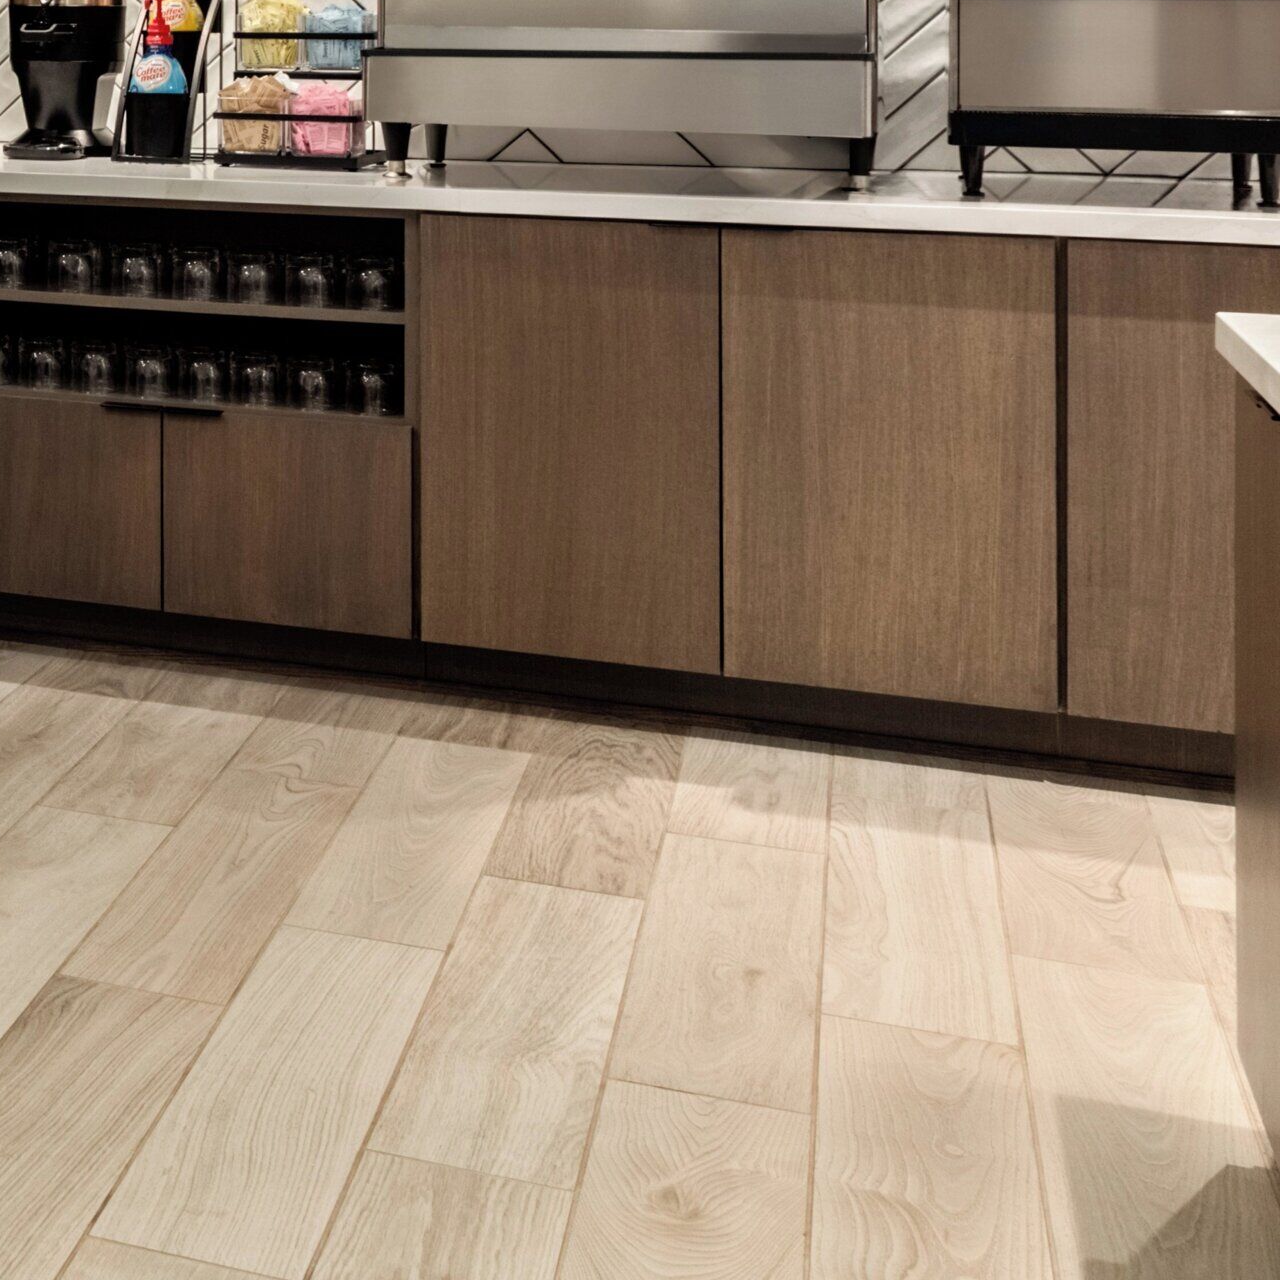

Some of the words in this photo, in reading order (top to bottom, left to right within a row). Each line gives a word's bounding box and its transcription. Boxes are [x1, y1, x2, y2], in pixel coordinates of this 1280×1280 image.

[162, 6, 185, 18] offee
[136, 66, 166, 79] Coffee
[141, 72, 166, 83] mate
